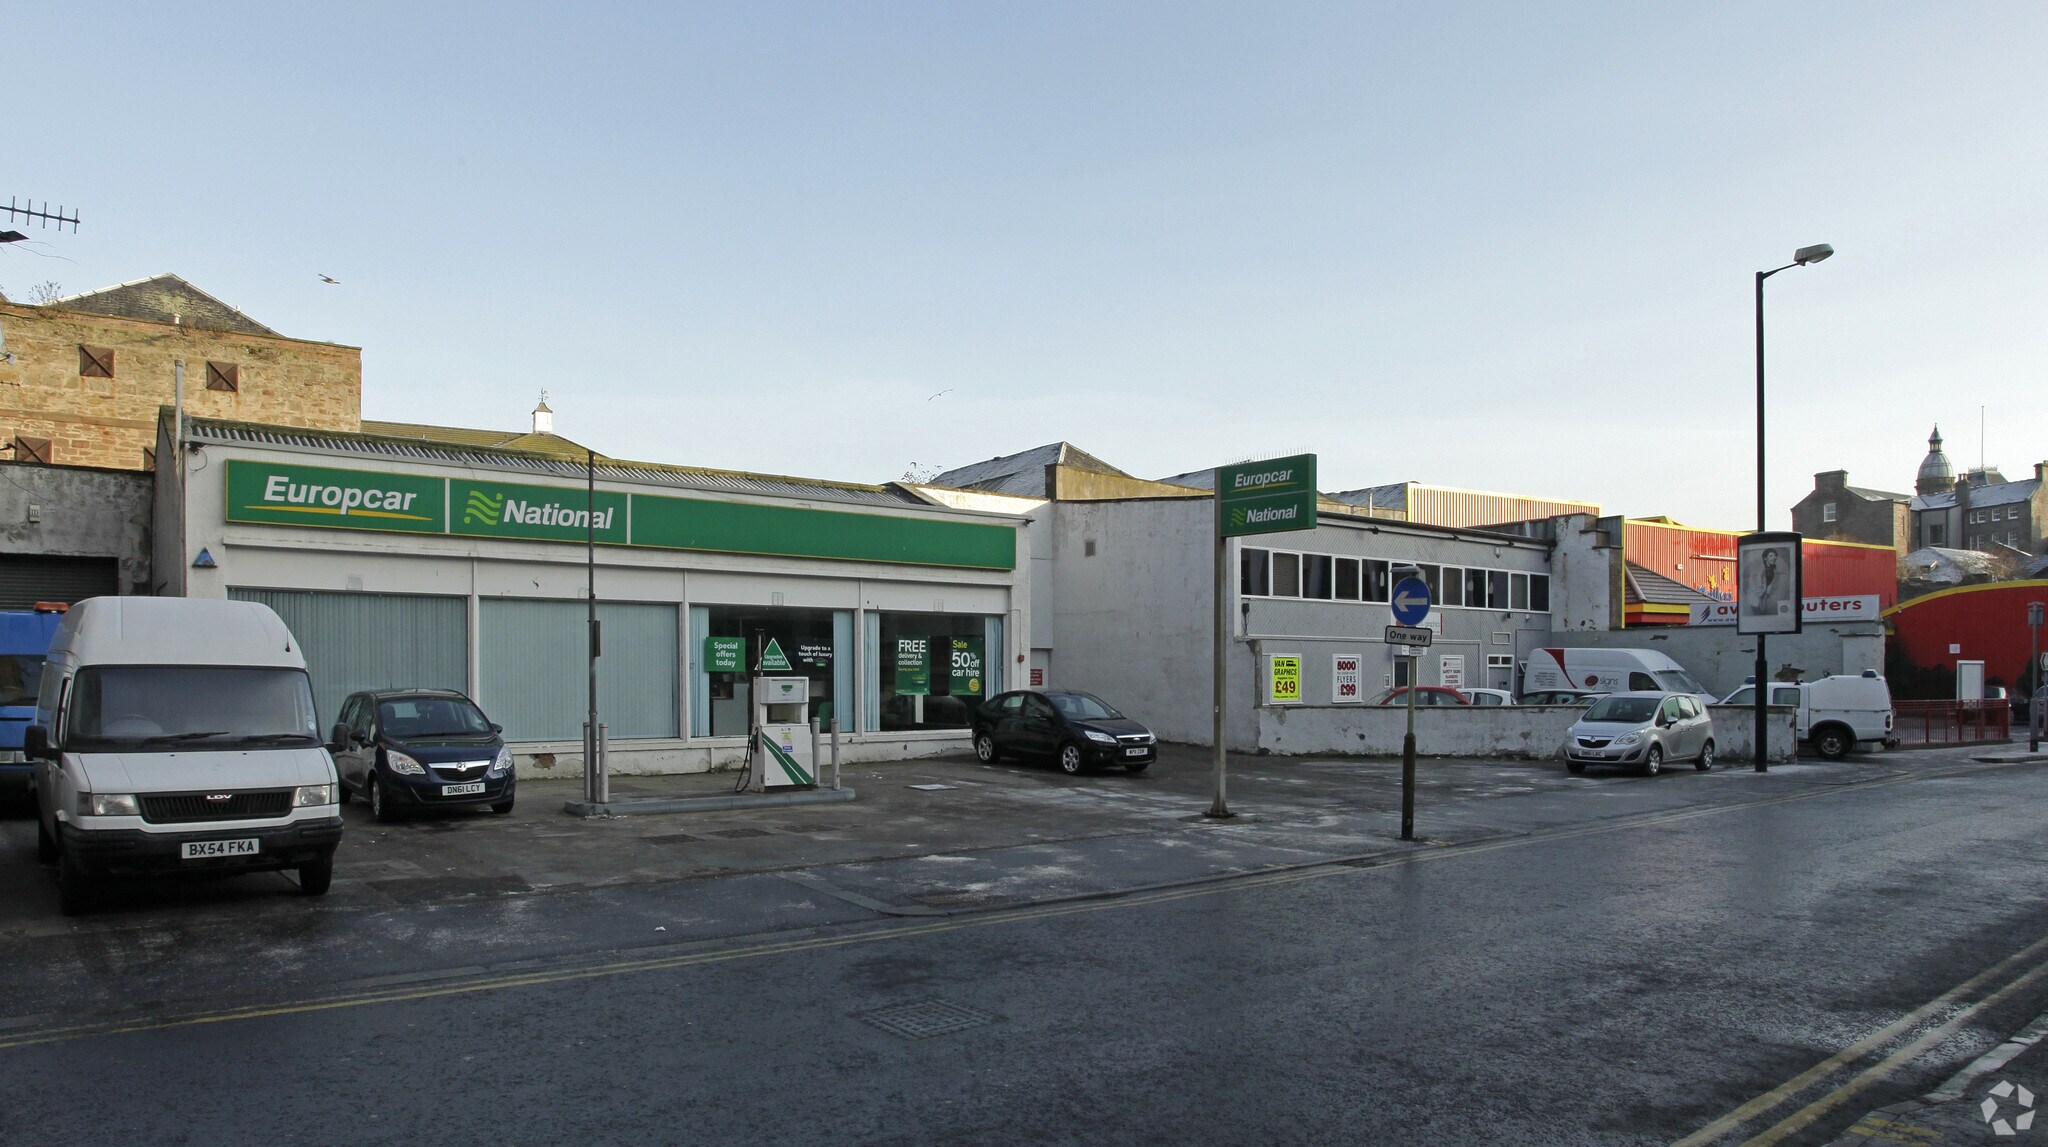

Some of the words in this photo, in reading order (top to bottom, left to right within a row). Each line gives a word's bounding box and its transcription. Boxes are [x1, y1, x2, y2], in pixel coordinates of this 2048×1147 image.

[1234, 469, 1294, 488] Europcar
[263, 475, 417, 515] Europcar
[503, 500, 614, 529] National
[1246, 504, 1298, 523] National
[1801, 599, 1862, 612] uters
[1389, 631, 1407, 640] One
[1410, 634, 1428, 643] way
[713, 642, 738, 650] Special
[898, 640, 927, 652] FREE
[952, 640, 968, 649] Sale
[716, 650, 736, 658] offers
[716, 659, 736, 668] today
[970, 659, 980, 668] off
[1337, 660, 1356, 671] 5000
[952, 669, 965, 677] car
[965, 668, 980, 677] hire
[1337, 675, 1356, 683] FLYERS
[1275, 680, 1296, 694] £49
[1340, 683, 1356, 696] £99
[465, 784, 481, 793] LCY
[188, 842, 225, 856] BX54
[228, 840, 254, 853] FKA
